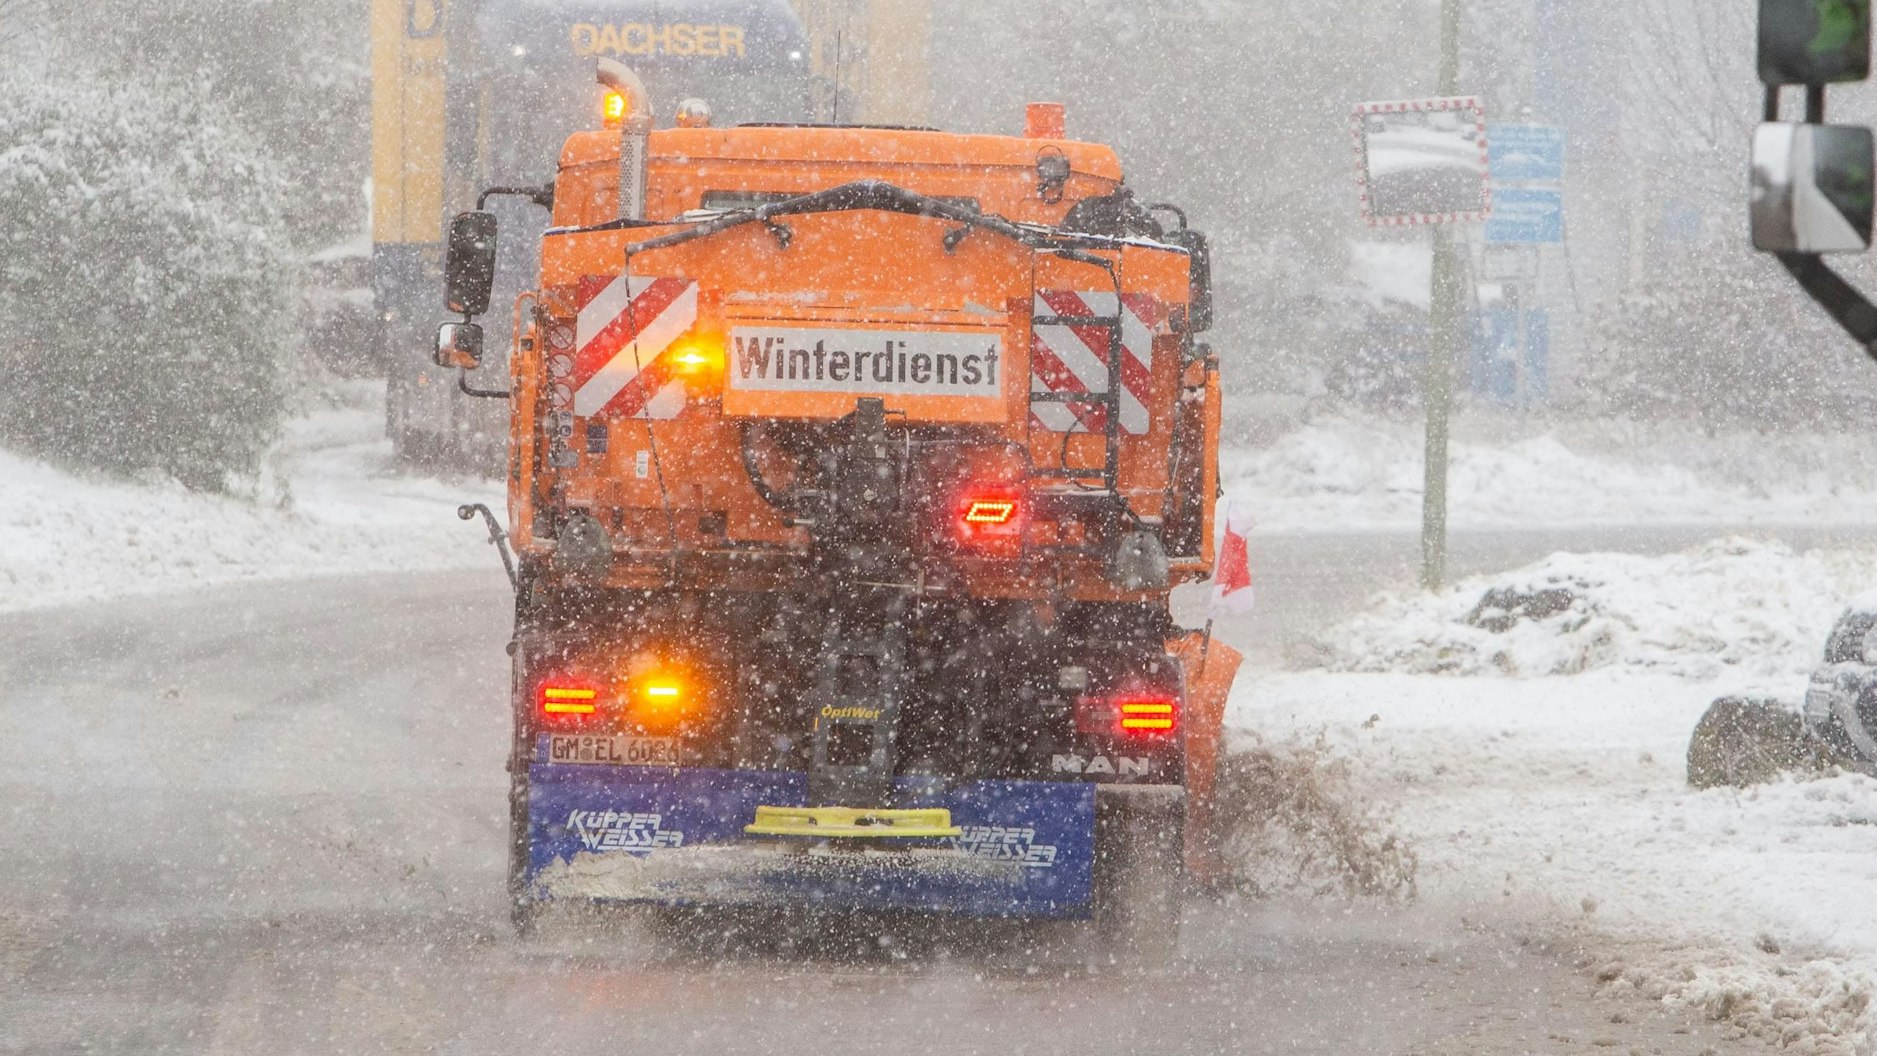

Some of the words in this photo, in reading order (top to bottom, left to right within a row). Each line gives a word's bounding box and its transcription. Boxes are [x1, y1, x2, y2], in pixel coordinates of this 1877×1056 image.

[571, 22, 746, 58] DACHSER
[734, 336, 999, 386] Winterdienst
[821, 706, 880, 720] OptiWet
[552, 736, 579, 760] GM
[595, 738, 621, 762] EL
[1052, 754, 1149, 776] MAN
[566, 809, 662, 830] KÜPPER
[581, 829, 683, 850] WEISSER
